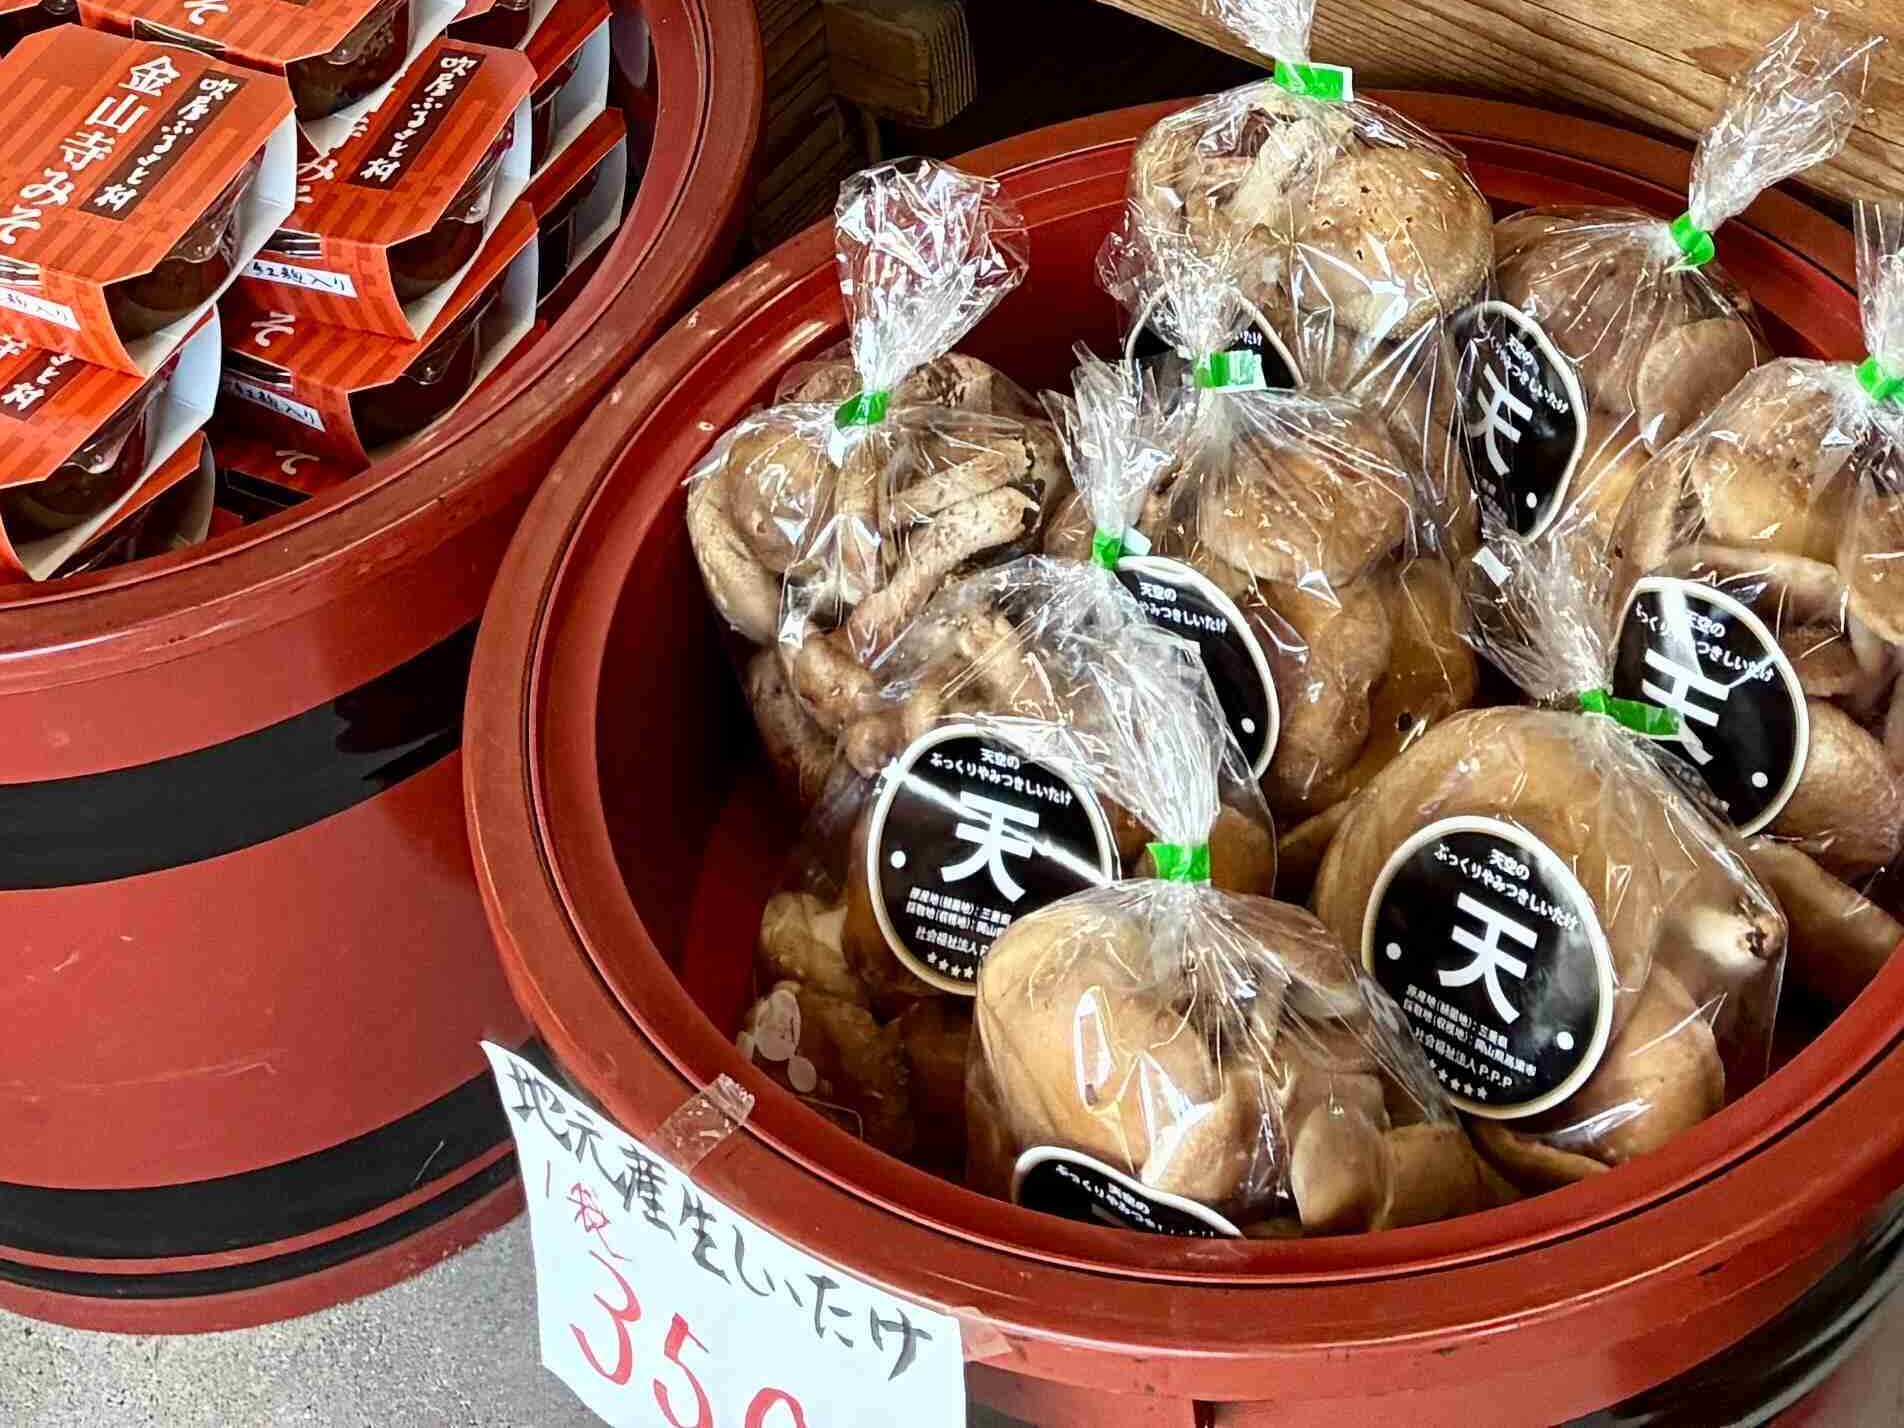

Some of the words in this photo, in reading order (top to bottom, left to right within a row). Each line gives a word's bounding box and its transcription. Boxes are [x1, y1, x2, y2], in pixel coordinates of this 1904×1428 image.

[1466, 359, 1534, 477] 天
[980, 747, 1020, 770] 天空の
[940, 790, 1040, 903] 天
[1488, 848, 1530, 881] 天空の
[1437, 892, 1538, 1025] 天
